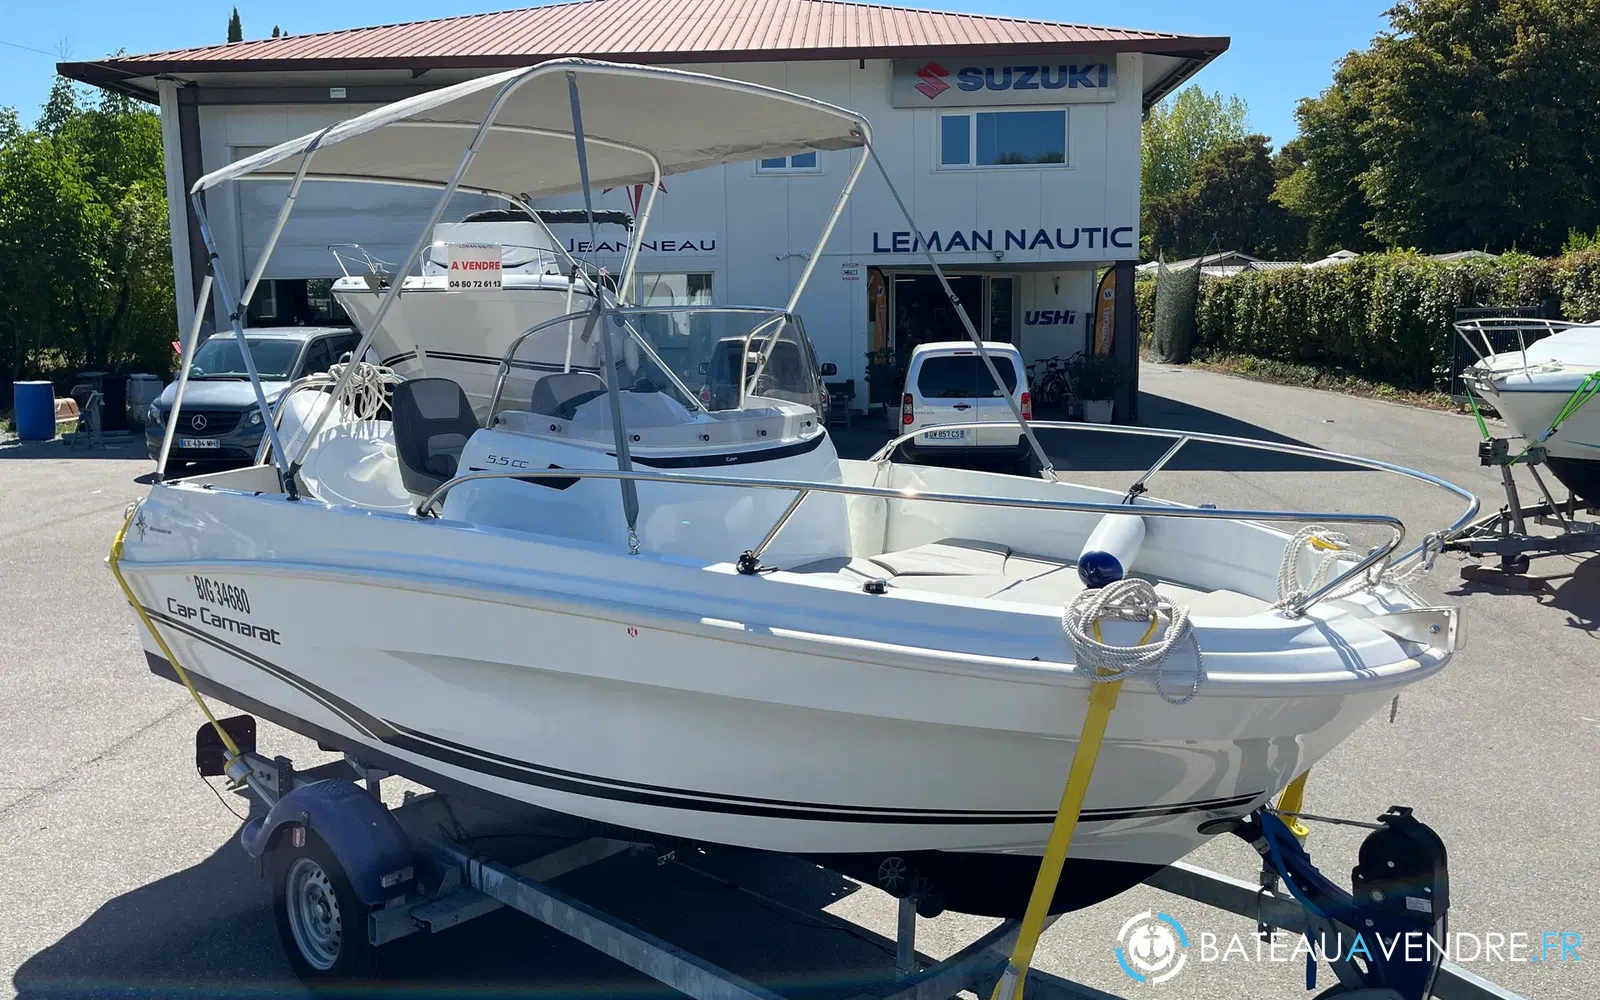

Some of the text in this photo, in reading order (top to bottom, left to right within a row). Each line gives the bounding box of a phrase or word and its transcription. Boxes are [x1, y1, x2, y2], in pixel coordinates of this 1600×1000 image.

[957, 63, 1108, 92] SUZUKI
[566, 238, 716, 253] JEANNEAU
[873, 227, 1133, 253] LEMAN NAUTIC
[451, 261, 500, 270] A VENDRE
[449, 280, 460, 288] 04
[461, 280, 472, 288] 50
[473, 280, 482, 288] 72
[193, 575, 251, 615] BIG 34680
[166, 597, 281, 645] Cap Camarat
